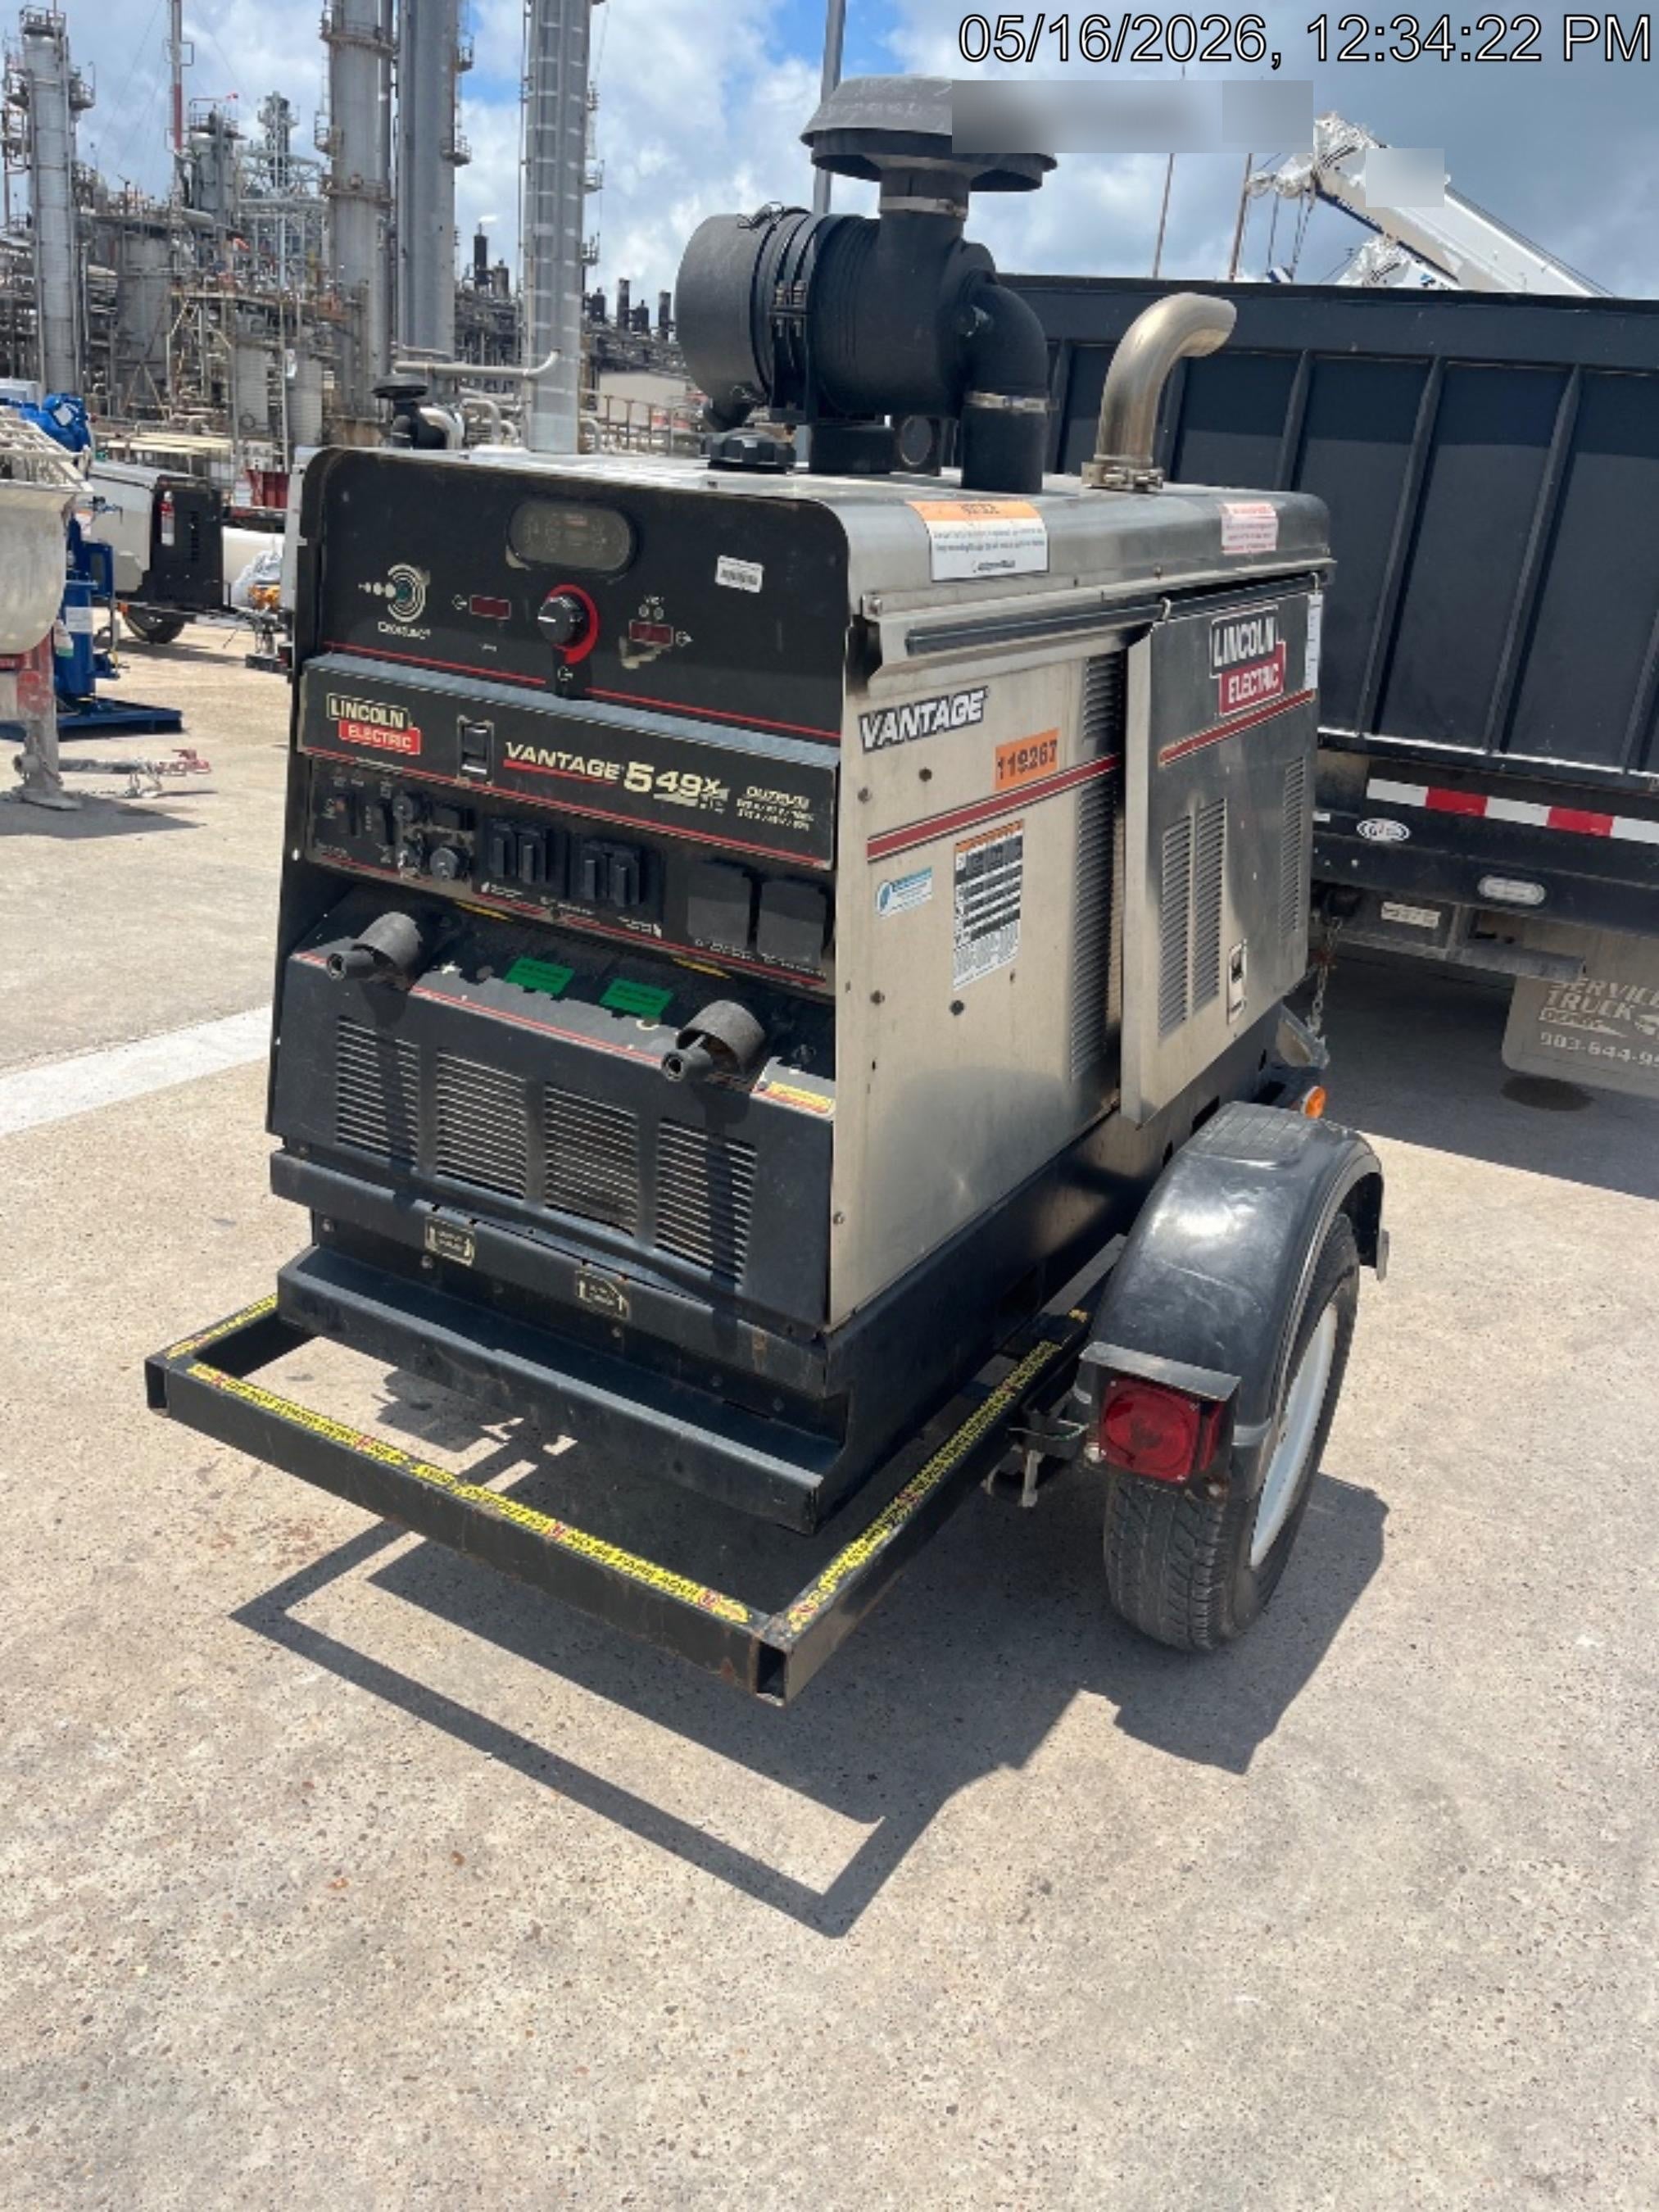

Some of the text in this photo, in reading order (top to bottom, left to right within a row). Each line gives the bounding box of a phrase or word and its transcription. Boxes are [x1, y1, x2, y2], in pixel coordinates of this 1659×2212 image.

[1213, 616, 1275, 667] LINCOLN
[1228, 662, 1279, 704] ELECTRIC
[330, 697, 404, 729] LINCOLN
[860, 688, 986, 750] VANTAGE
[347, 724, 412, 749] ELECTRIC
[505, 741, 621, 780] VANTAGE
[997, 740, 1058, 780] 119267
[1546, 990, 1635, 1021] TRUCK
